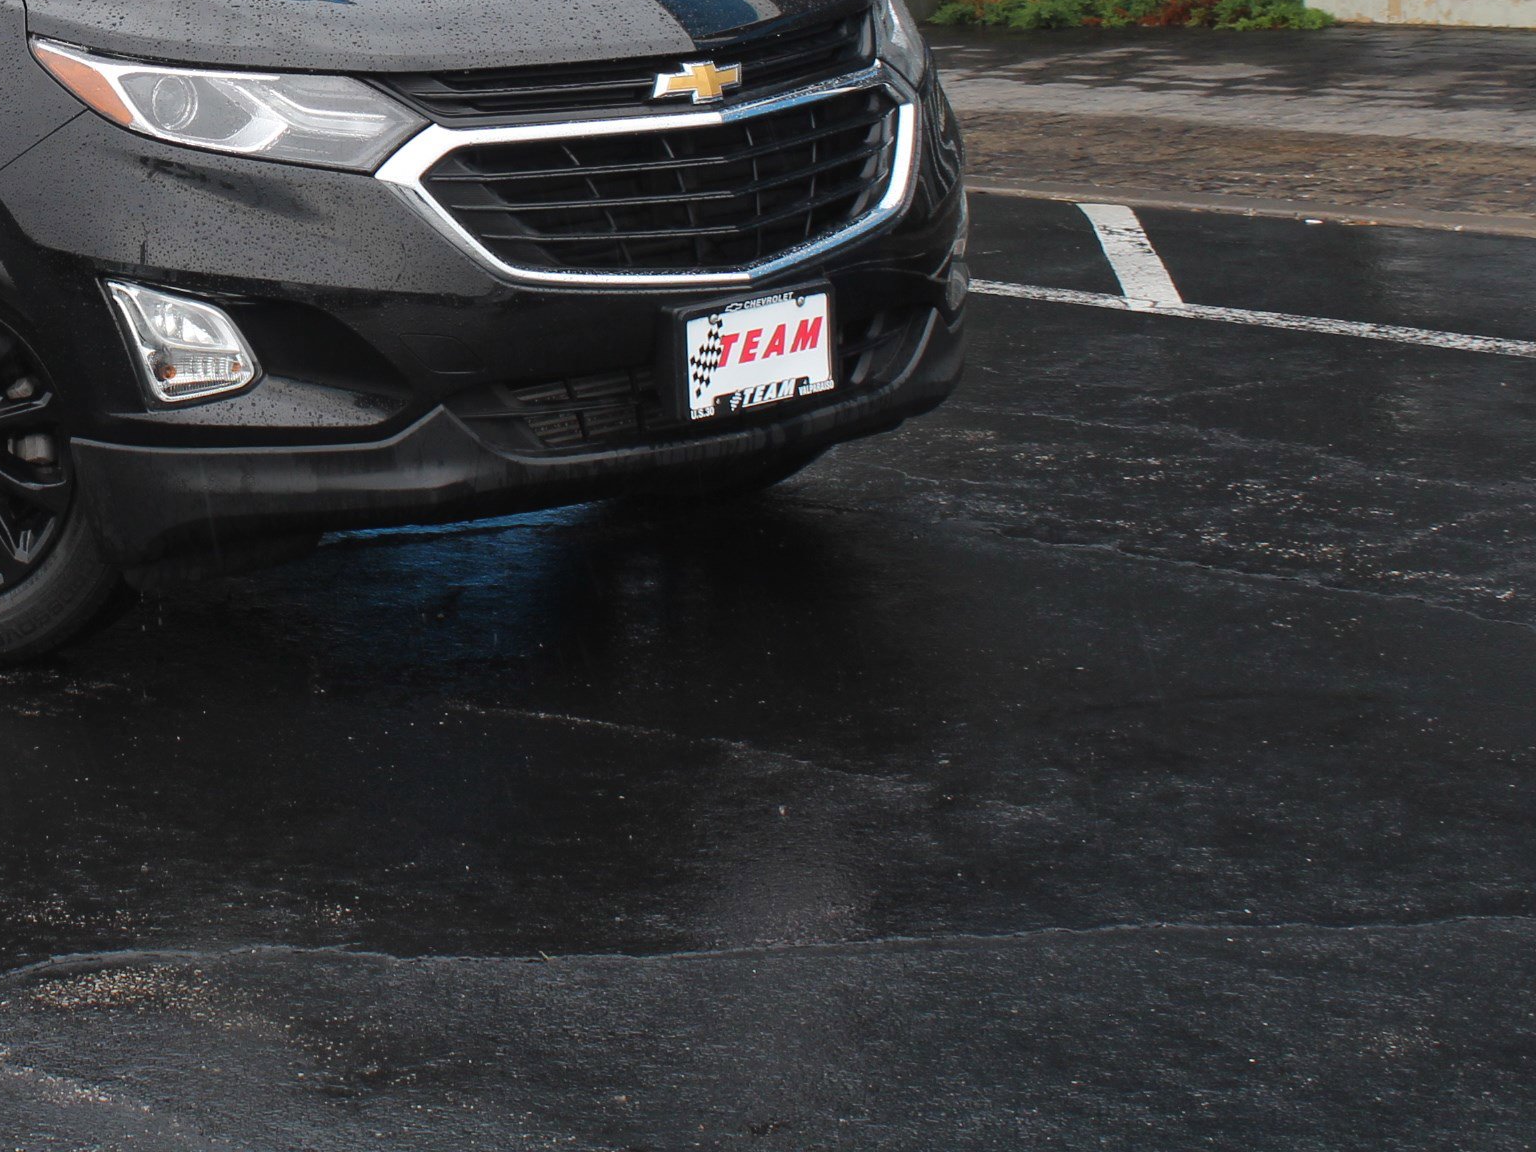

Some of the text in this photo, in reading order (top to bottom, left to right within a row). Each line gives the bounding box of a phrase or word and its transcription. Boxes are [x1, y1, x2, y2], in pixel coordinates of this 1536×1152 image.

[743, 292, 795, 310] CHEVROLET
[717, 316, 824, 368] TEAM
[742, 378, 797, 407] TEAM
[798, 380, 835, 396] VALPARAISO
